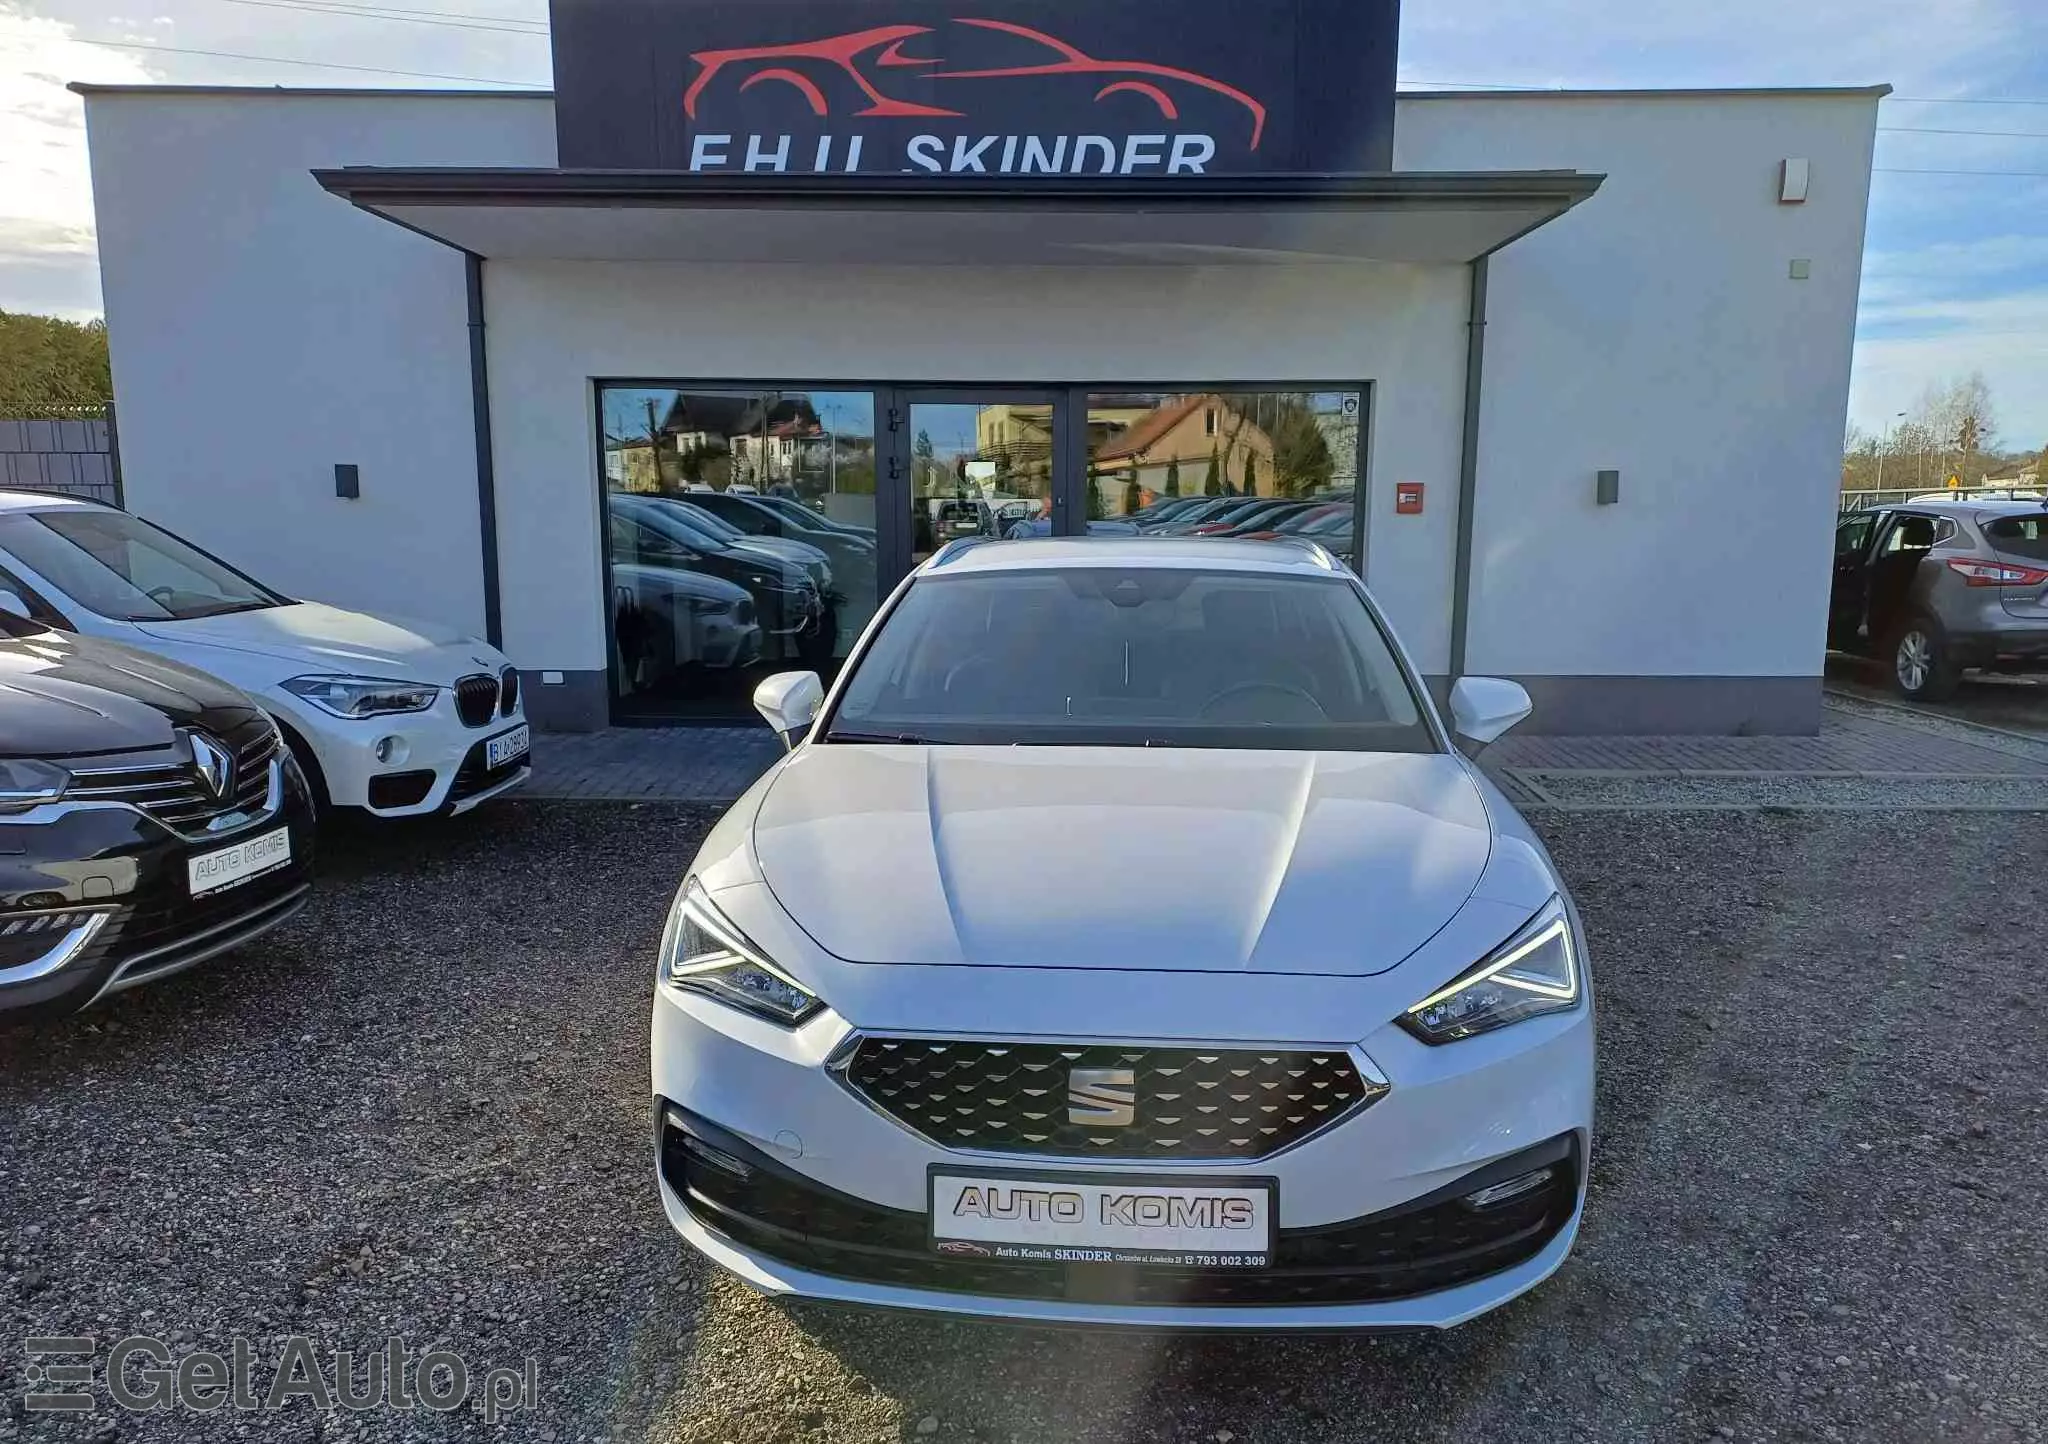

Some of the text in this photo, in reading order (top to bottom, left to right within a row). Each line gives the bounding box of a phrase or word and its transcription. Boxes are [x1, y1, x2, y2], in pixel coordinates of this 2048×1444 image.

[902, 134, 1216, 174] SKINDER
[195, 849, 240, 880] AUTO
[243, 832, 285, 864] KOMIS
[953, 1186, 1254, 1230] AUTO KOMIS
[995, 1247, 1019, 1258] Auto
[1021, 1248, 1051, 1260] Komis
[1054, 1249, 1112, 1262] SKINDER
[1196, 1255, 1218, 1266] 793
[1220, 1255, 1242, 1266] 002
[1244, 1256, 1266, 1266] 309
